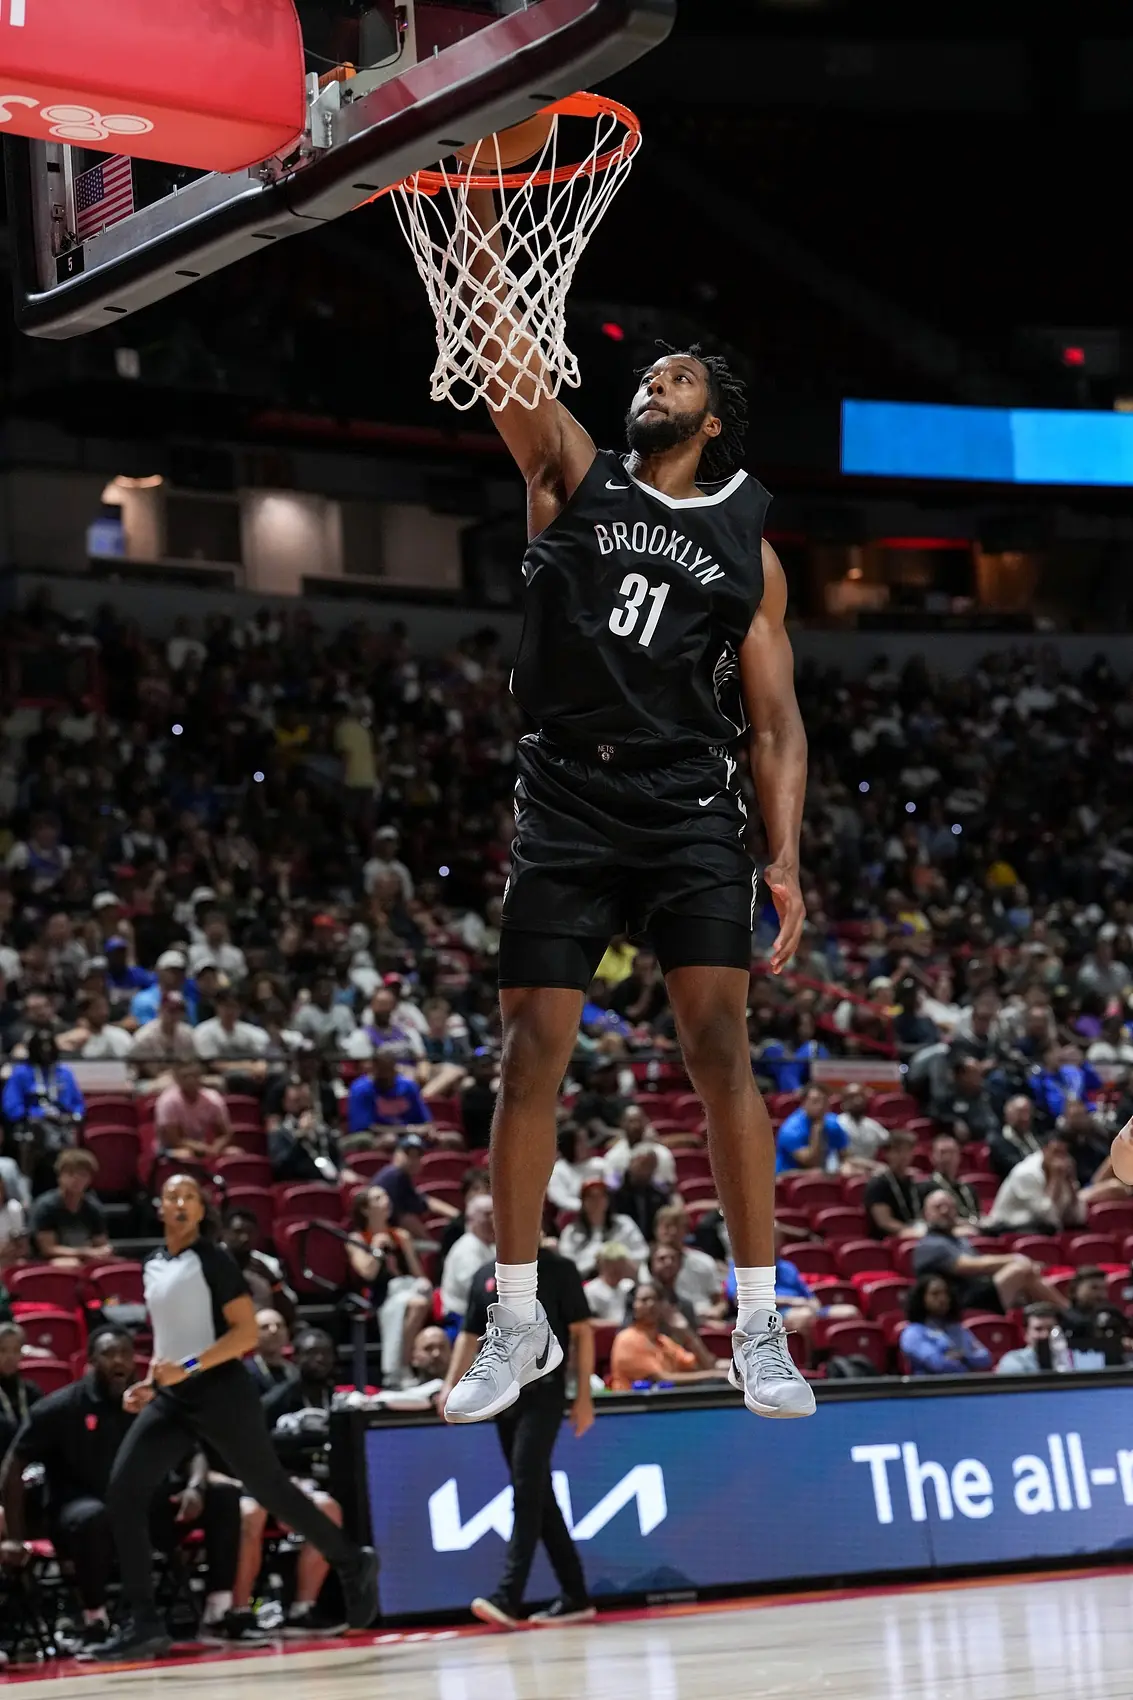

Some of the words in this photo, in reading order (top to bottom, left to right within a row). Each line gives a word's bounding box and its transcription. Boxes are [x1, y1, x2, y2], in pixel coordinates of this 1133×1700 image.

[67, 256, 73, 272] 5
[593, 521, 726, 586] BROOKLYN
[608, 572, 671, 647] 31
[597, 745, 615, 754] NETS
[851, 1441, 994, 1524] The
